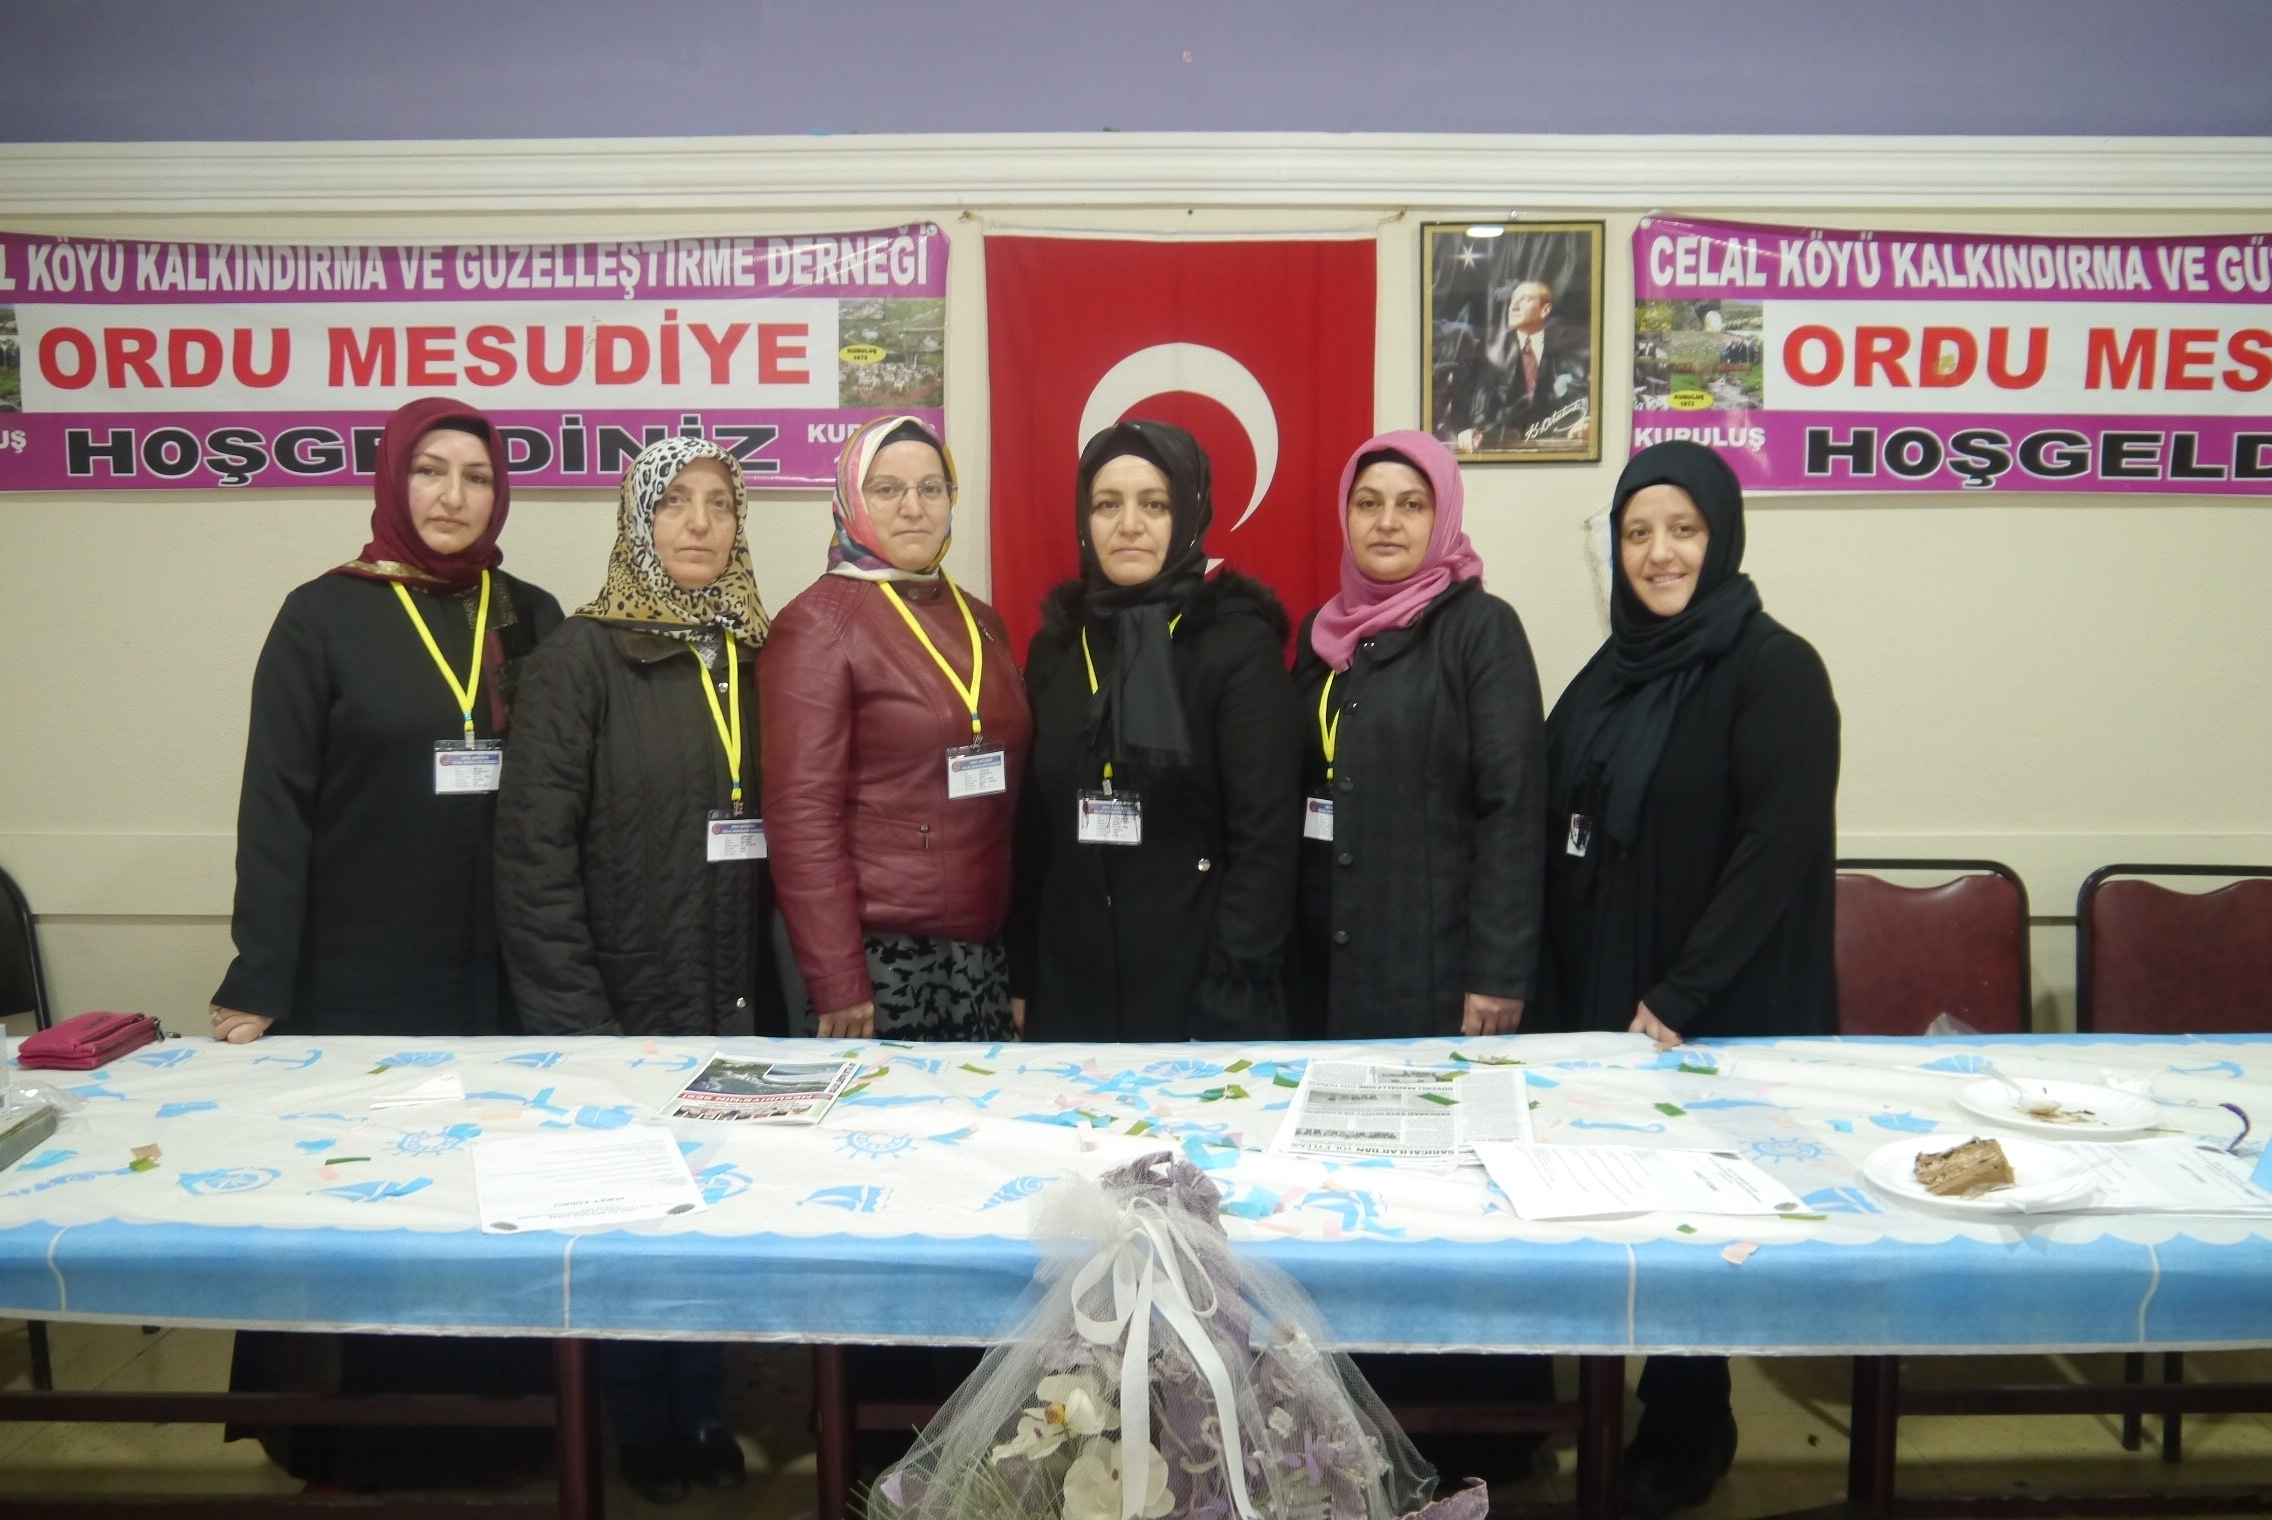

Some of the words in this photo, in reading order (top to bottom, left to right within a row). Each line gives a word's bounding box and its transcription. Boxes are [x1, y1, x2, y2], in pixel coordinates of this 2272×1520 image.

[28, 236, 125, 292] KÖYÜ
[136, 243, 388, 292] KALKINDIRMA
[396, 246, 446, 291] VE
[767, 223, 928, 287] DERNEĞİ
[1650, 235, 1768, 288] CELAL
[1778, 230, 1881, 289] KÖYÜ
[1892, 240, 2152, 291] KALKINDIRMA
[2157, 245, 2210, 291] VE
[38, 326, 292, 390] ORDU
[327, 308, 811, 388] MESUDİYE
[1782, 324, 2050, 388] ORDU
